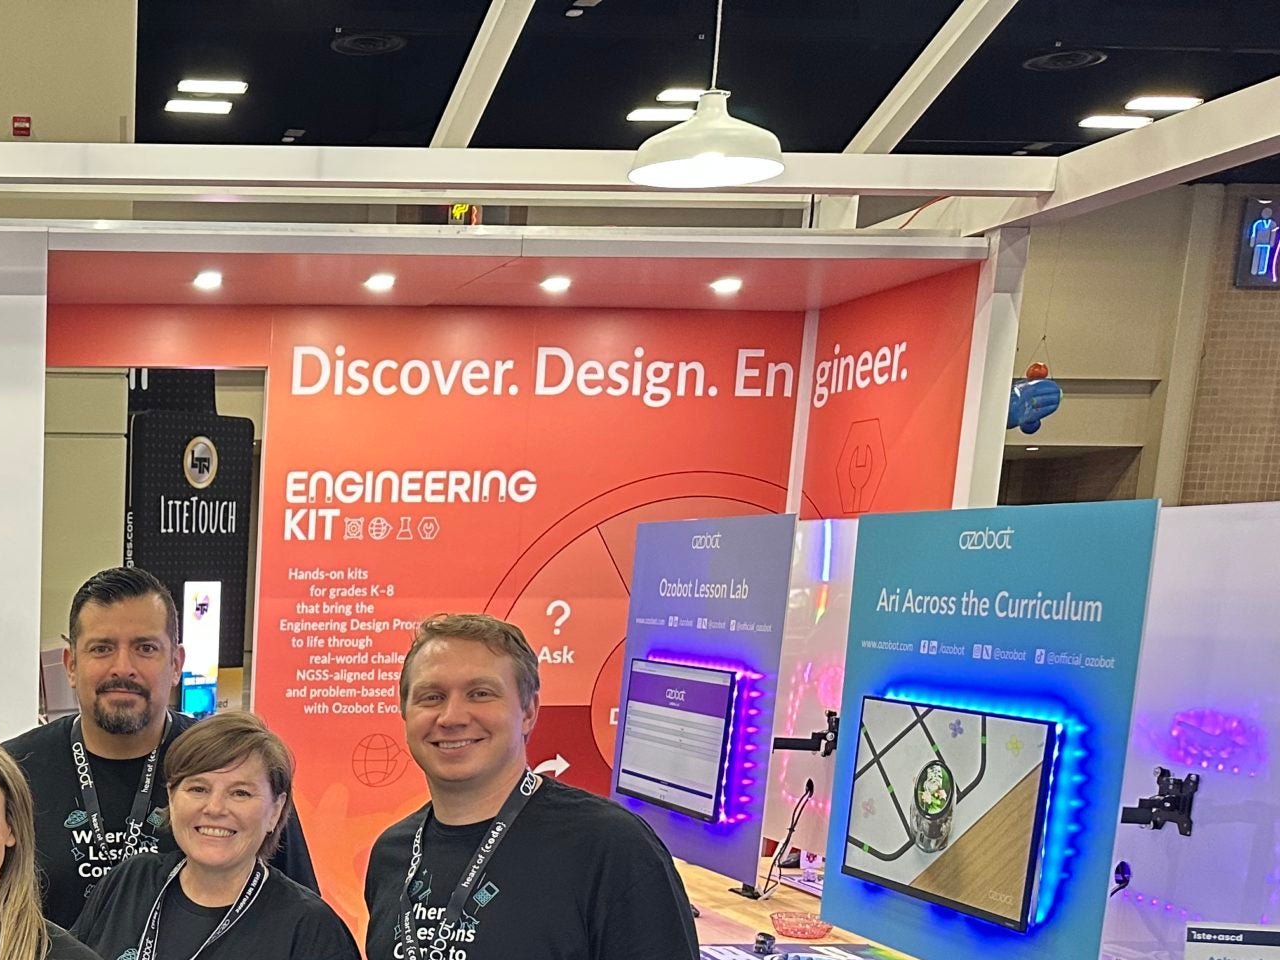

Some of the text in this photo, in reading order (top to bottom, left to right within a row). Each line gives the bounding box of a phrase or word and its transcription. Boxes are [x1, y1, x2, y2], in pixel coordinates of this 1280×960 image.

[290, 344, 519, 398] Discover.
[534, 345, 718, 408] Design.
[285, 469, 537, 504] ENGINEERING
[283, 508, 341, 542] KIT
[691, 532, 722, 550] ozobot
[958, 527, 1015, 550] ozobot
[288, 567, 369, 581] Hands-on kits
[309, 584, 327, 597] for
[328, 584, 368, 599] grades
[659, 577, 749, 600] Ozobot Lesson Lab
[296, 602, 375, 616] that bring the
[876, 587, 1104, 622] Ari Across the Curriculum
[279, 618, 348, 633] Engineering
[350, 618, 390, 633] Design
[291, 636, 373, 649] to life through
[309, 652, 369, 665] real-world
[538, 645, 575, 664] Ask
[296, 669, 402, 683] NGSS-aligned less
[285, 686, 307, 698] and
[309, 686, 395, 700] problem-based
[303, 702, 402, 714] with Ozobot Evo.
[72, 741, 93, 790] ozobot
[141, 773, 153, 793] heart
[461, 864, 480, 889] heart
[476, 853, 486, 865] of
